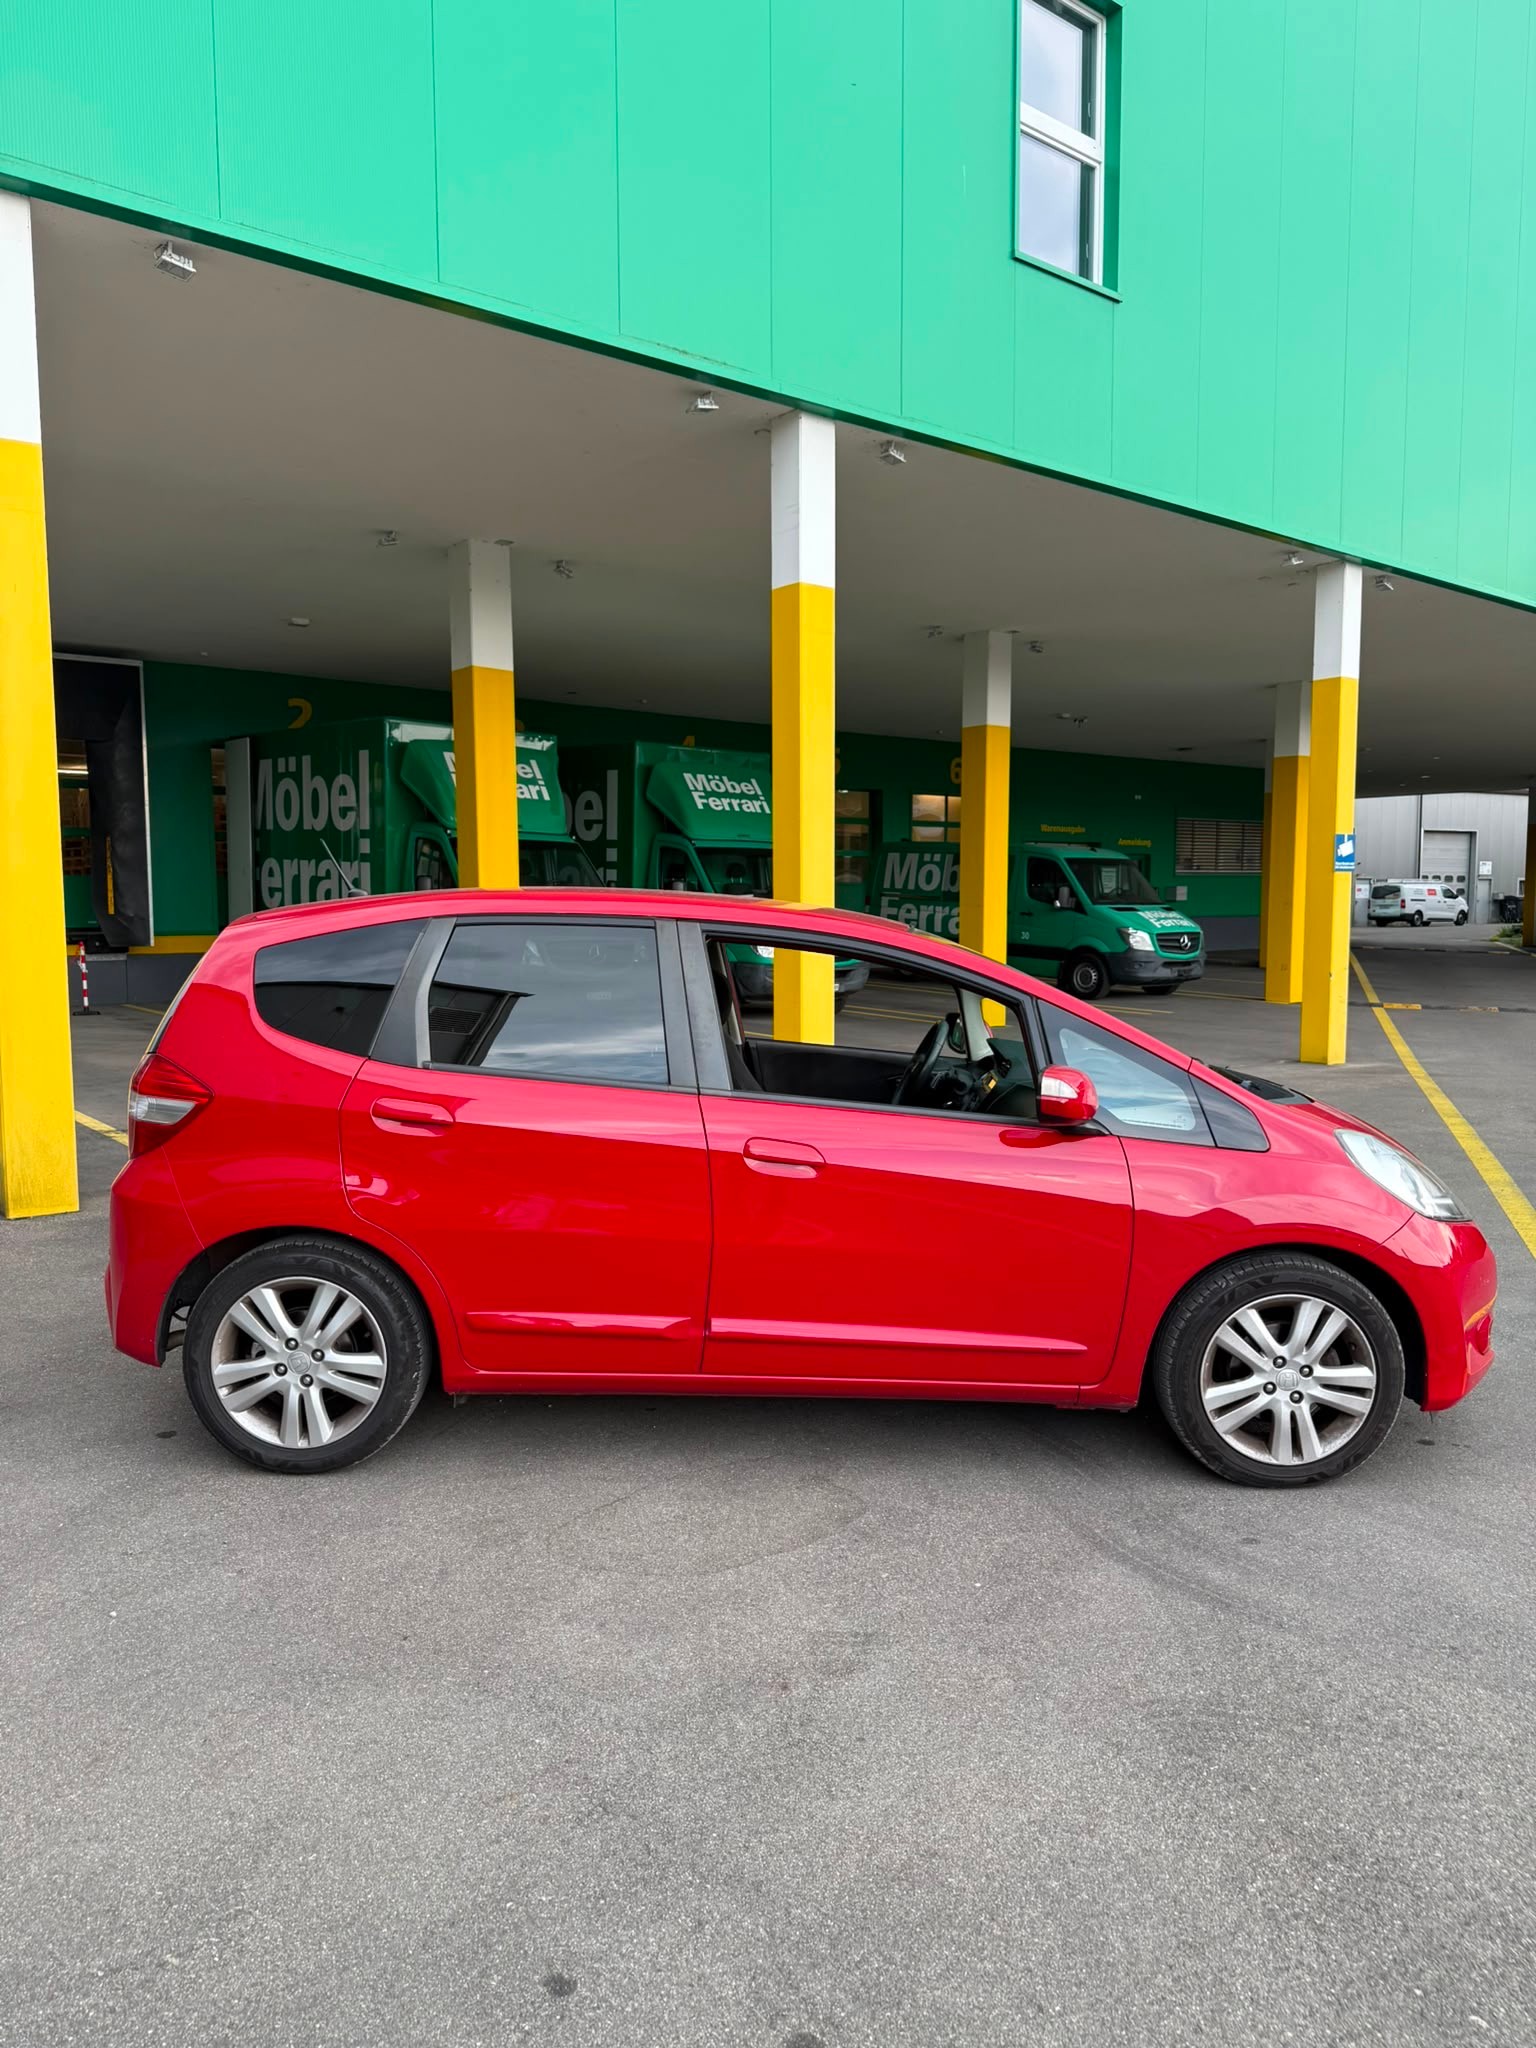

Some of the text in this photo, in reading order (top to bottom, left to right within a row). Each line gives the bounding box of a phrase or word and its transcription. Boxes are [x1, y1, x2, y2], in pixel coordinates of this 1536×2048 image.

[682, 772, 763, 796] Möbel
[691, 791, 771, 814] Ferrari
[258, 838, 371, 909] errari
[883, 852, 960, 892] Möb
